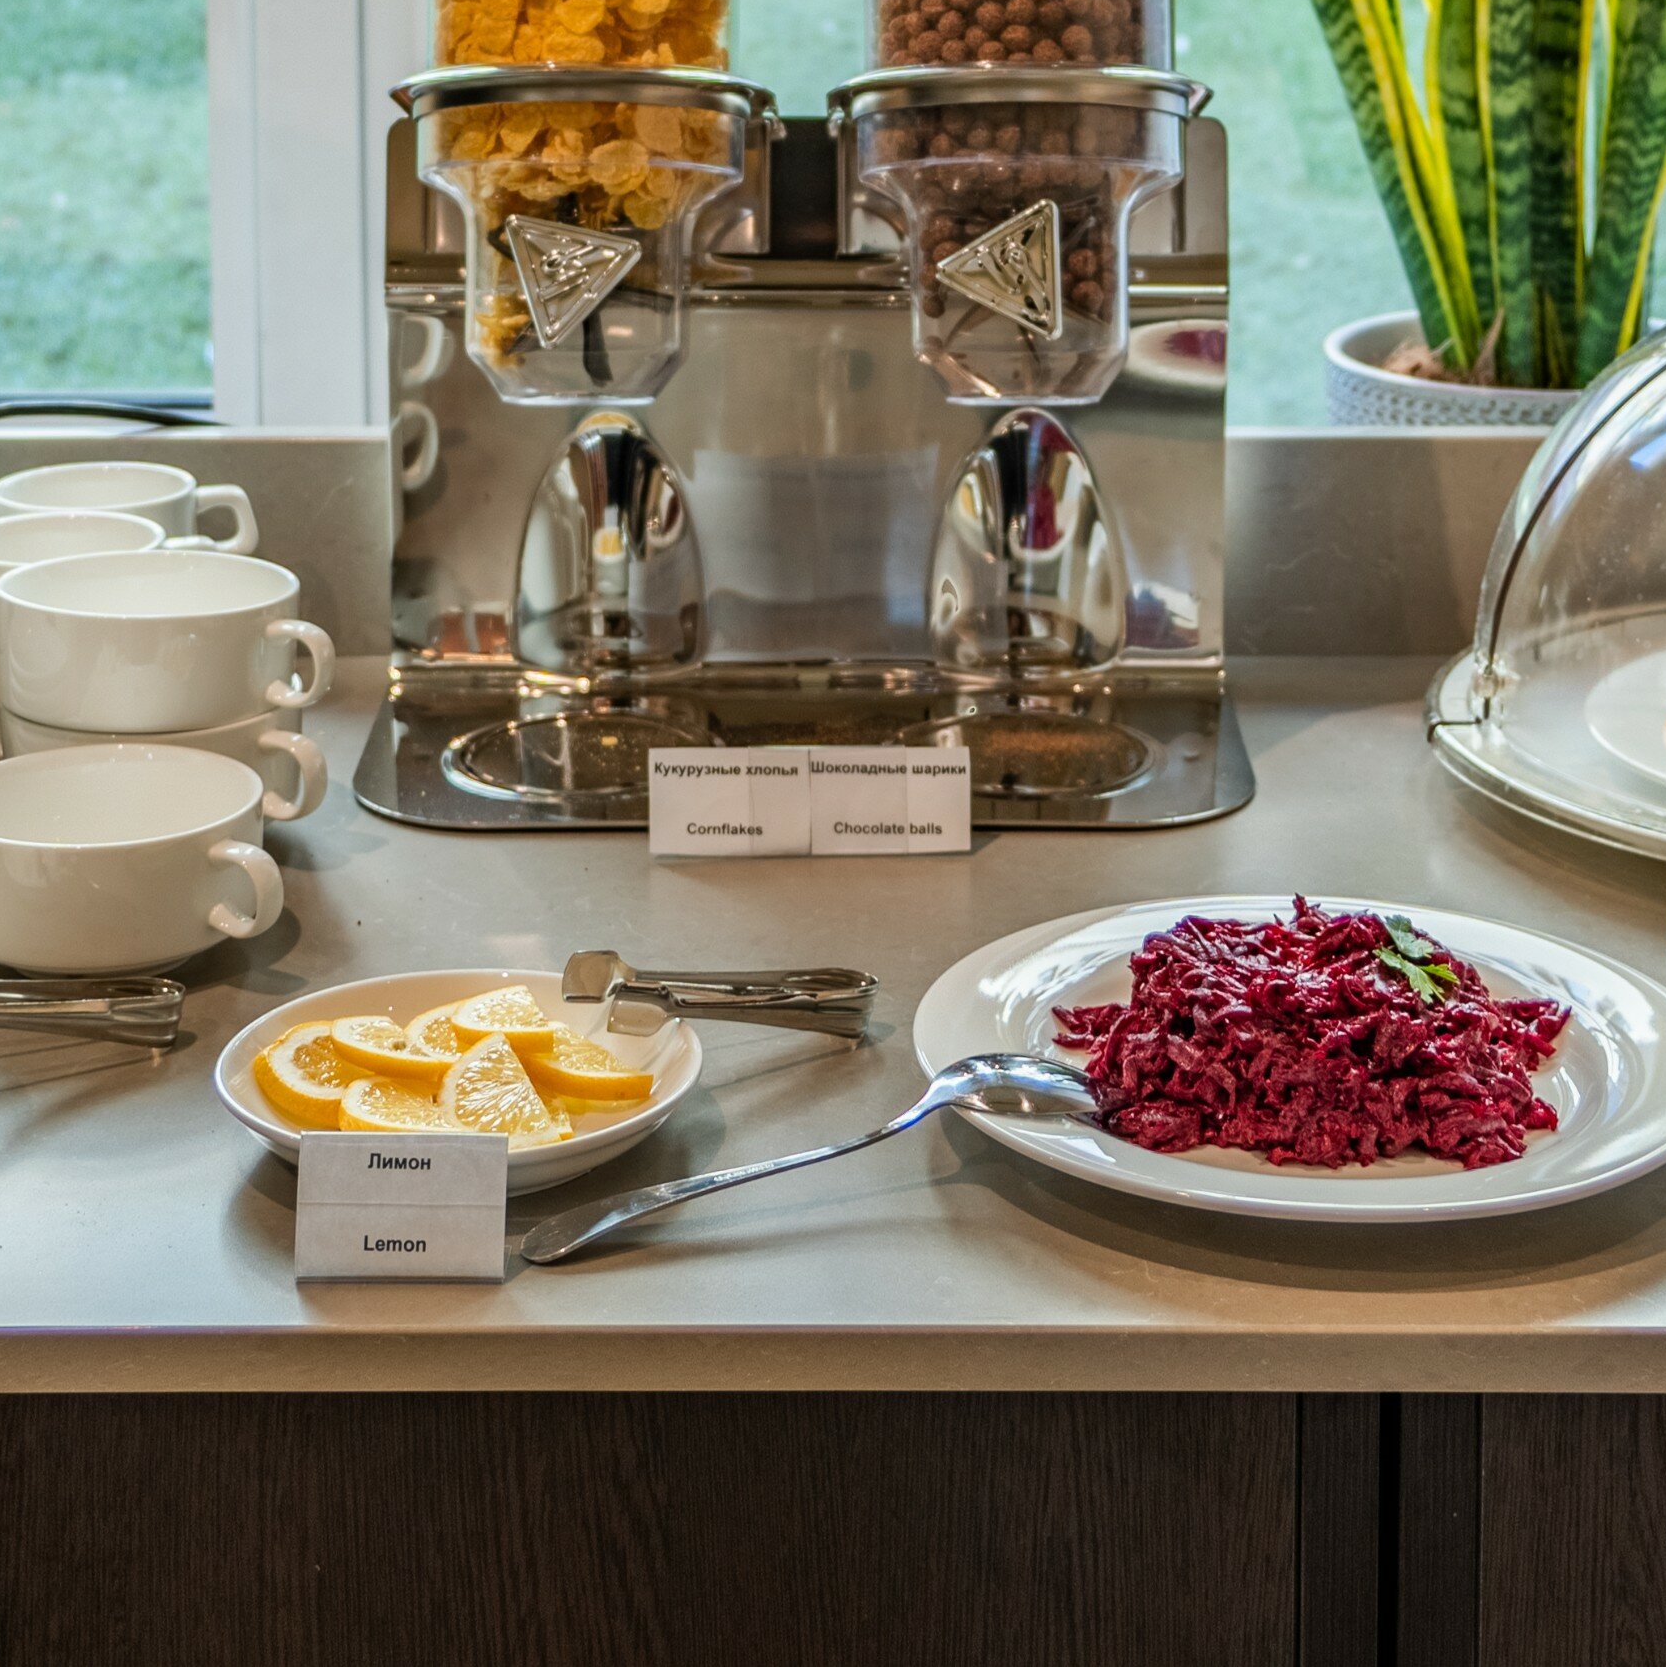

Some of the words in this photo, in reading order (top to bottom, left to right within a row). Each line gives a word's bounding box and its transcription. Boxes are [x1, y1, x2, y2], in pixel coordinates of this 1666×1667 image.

[654, 762, 742, 778] Кукурузные
[746, 764, 799, 776] хлопья
[810, 761, 908, 777] Шоколадные
[911, 765, 967, 777] шарики
[686, 822, 764, 836] Cornflakes
[833, 821, 906, 835] Chocolate
[909, 822, 943, 835] balls
[367, 1152, 432, 1171] Лимон
[363, 1235, 427, 1253] Lemon
